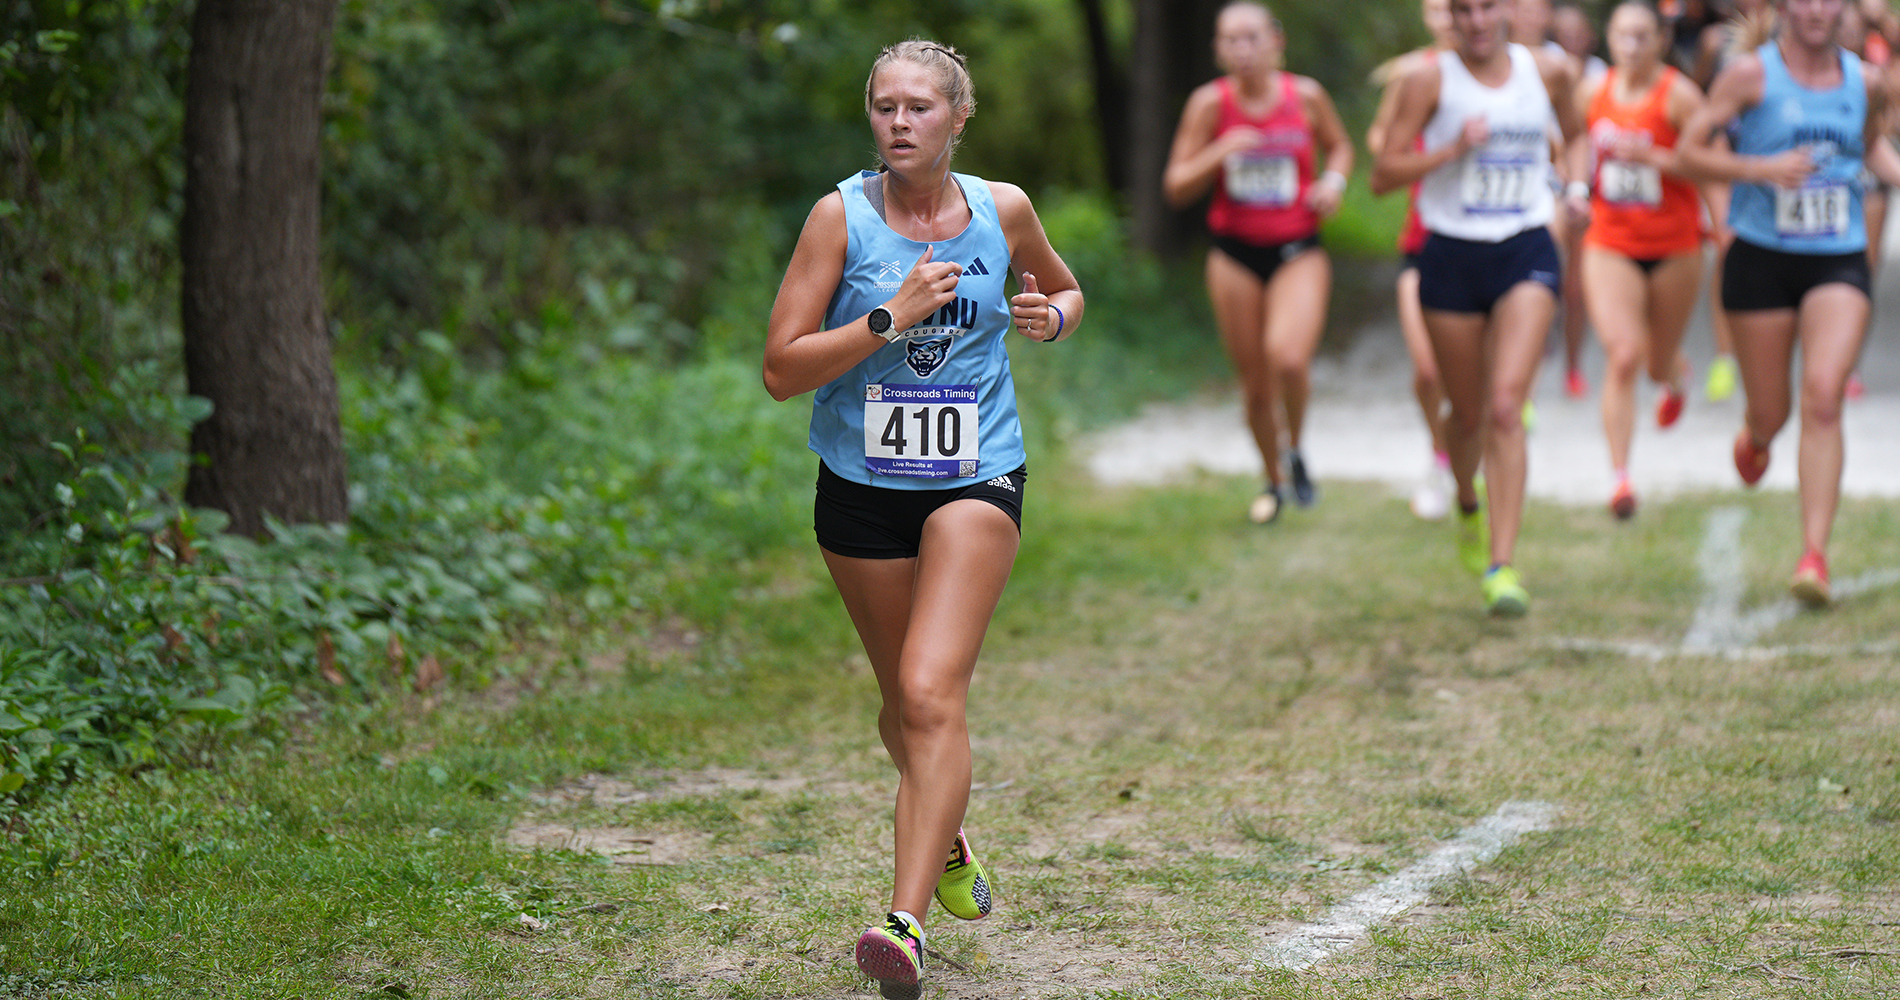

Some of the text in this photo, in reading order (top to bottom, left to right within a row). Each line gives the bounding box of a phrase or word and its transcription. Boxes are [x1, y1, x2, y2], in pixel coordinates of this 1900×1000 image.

[873, 281, 903, 289] CROSSROA
[908, 296, 978, 330] NU
[883, 387, 976, 400] Crossroads Timing
[880, 406, 961, 457] 410
[905, 461, 926, 469] Results
[986, 480, 1016, 493] adidas
